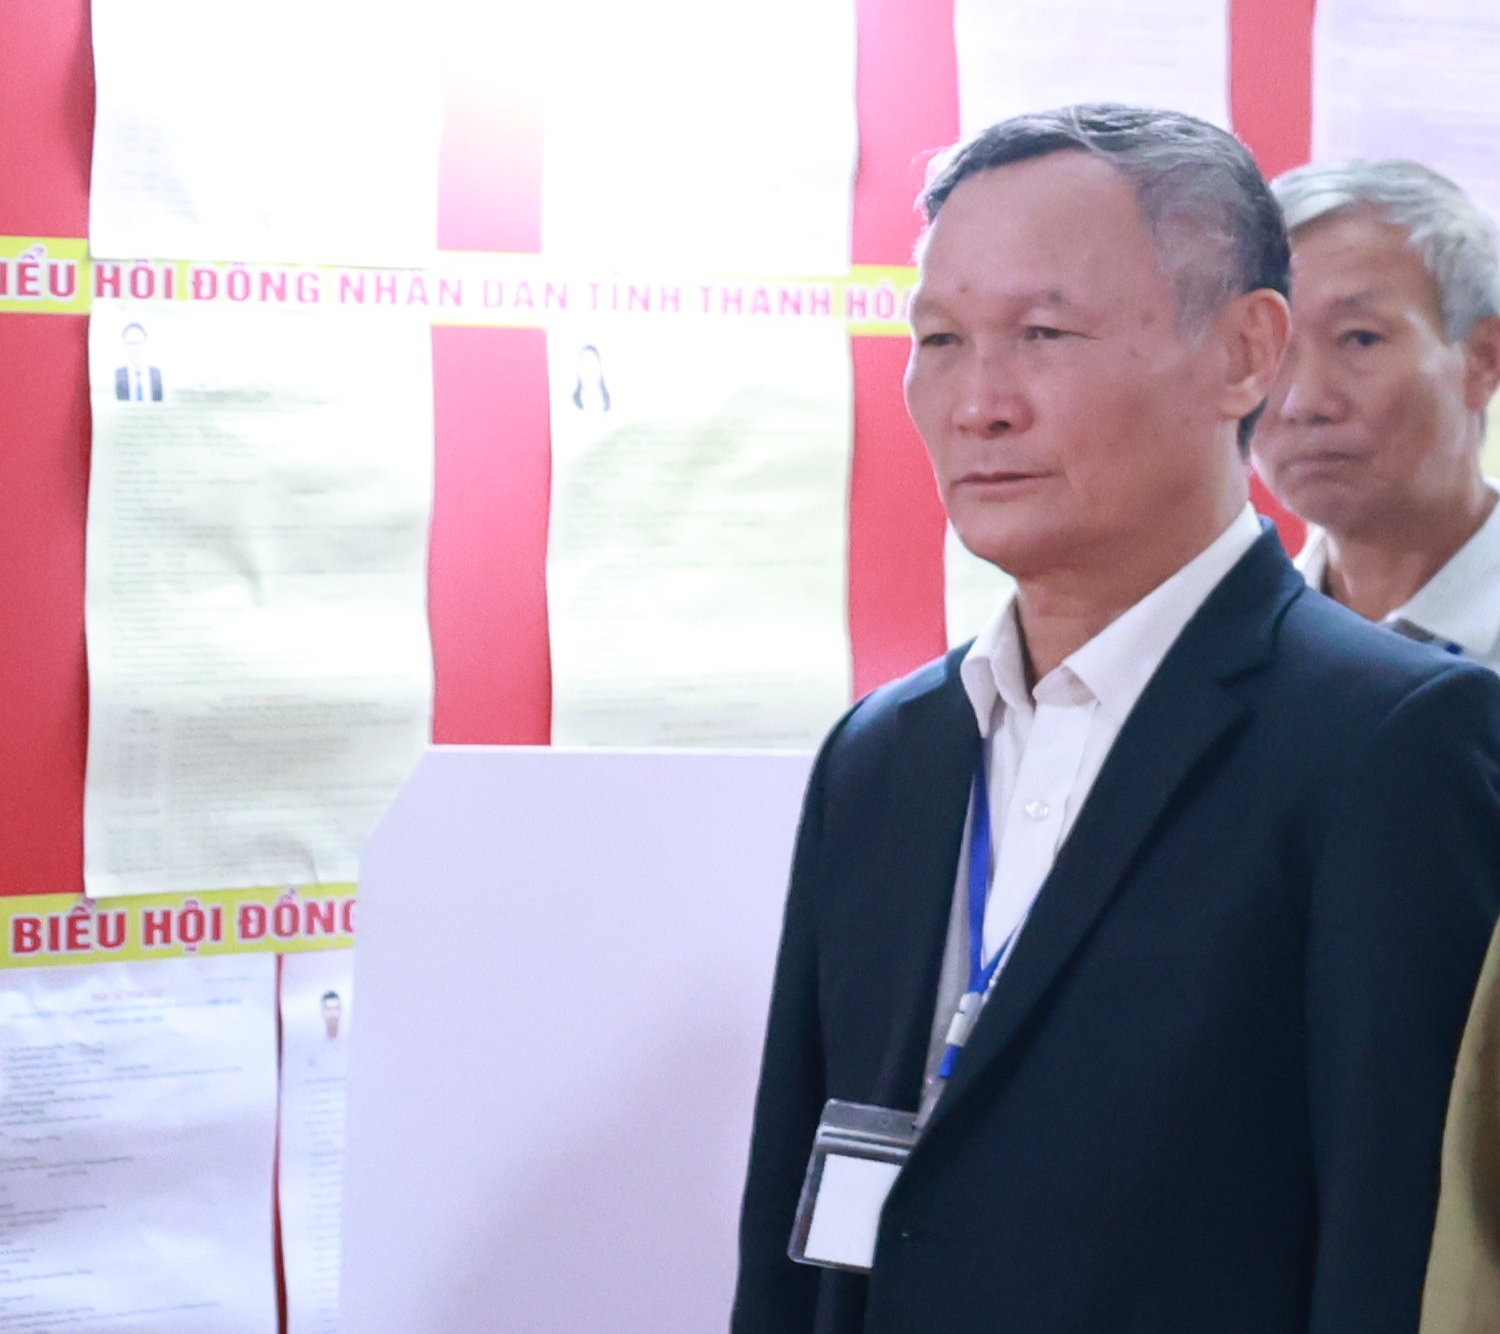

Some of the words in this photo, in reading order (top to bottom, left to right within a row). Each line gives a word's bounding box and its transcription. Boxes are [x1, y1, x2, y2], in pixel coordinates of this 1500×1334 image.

[699, 284, 831, 317] THANH
[847, 281, 910, 320] HÓ
[12, 897, 126, 953] BIỂU
[143, 899, 222, 952] HỘI
